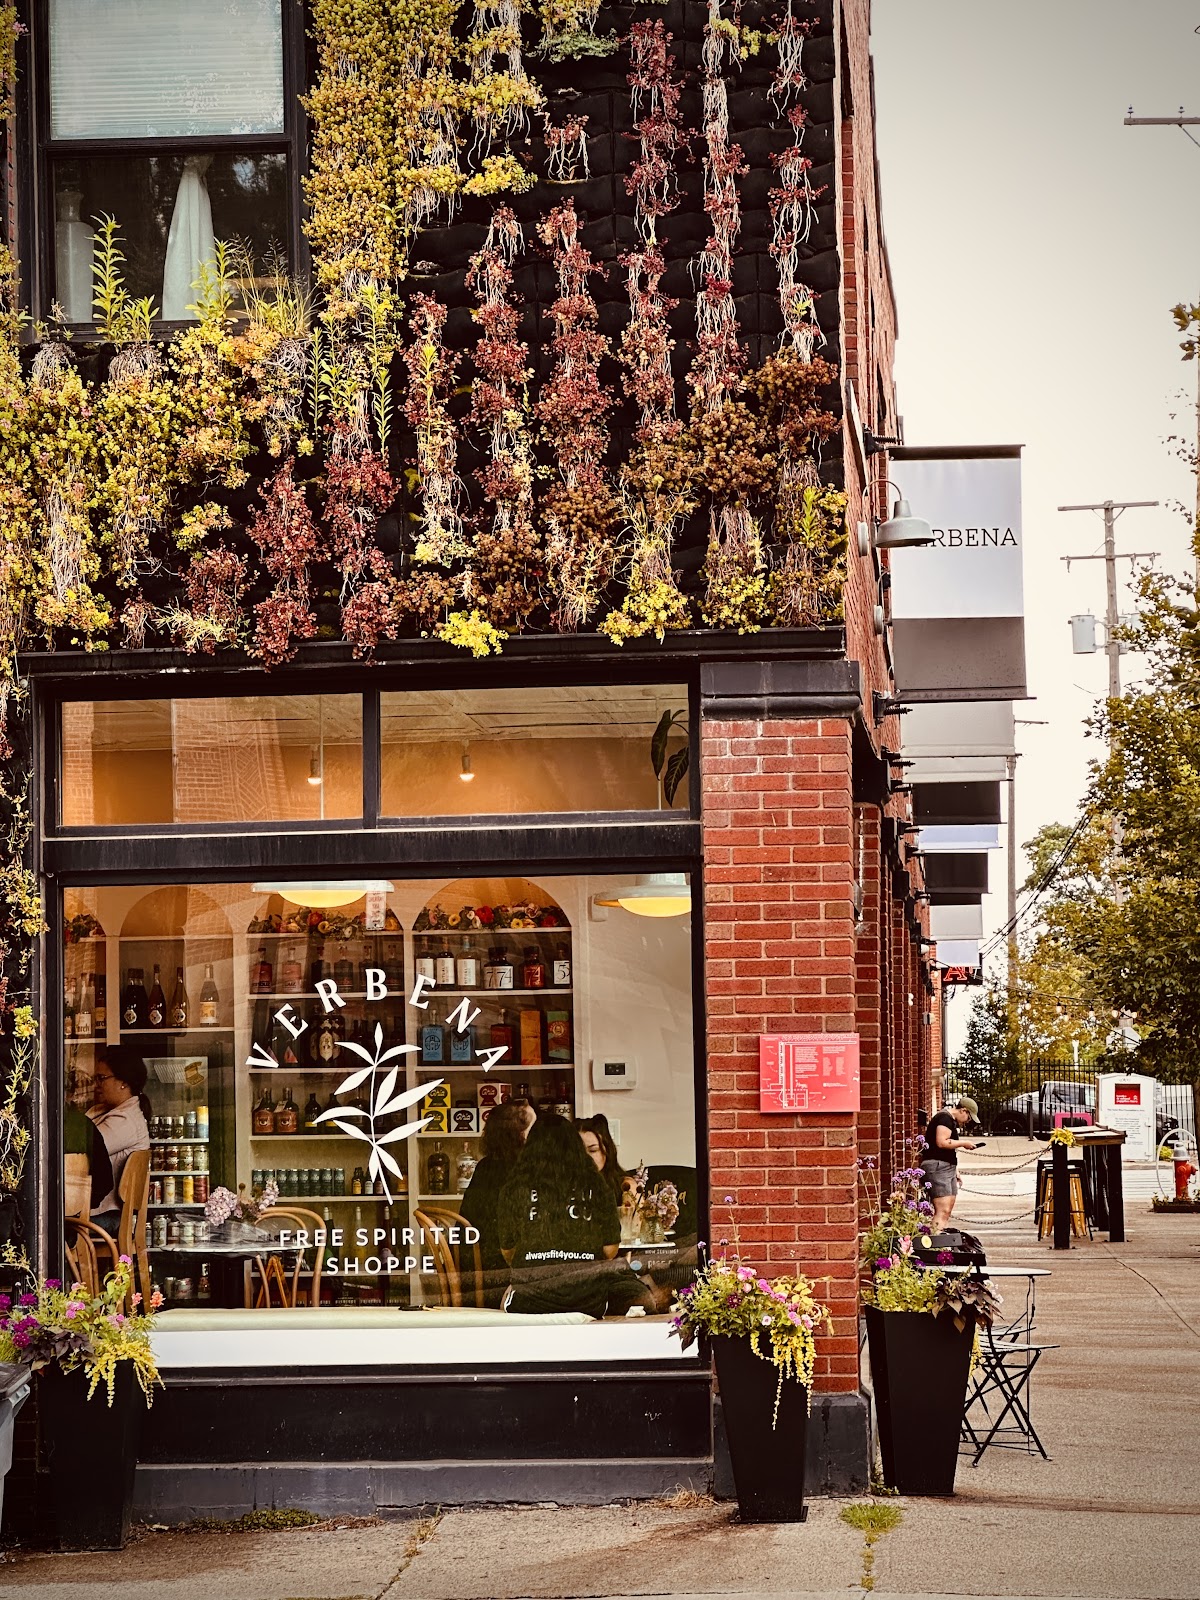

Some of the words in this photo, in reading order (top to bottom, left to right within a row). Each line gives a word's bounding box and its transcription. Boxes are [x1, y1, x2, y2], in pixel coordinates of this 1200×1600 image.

[914, 527, 1018, 547] RBENA
[245, 968, 509, 1072] VERBENA
[279, 1229, 344, 1248] FREE
[356, 1226, 481, 1247] SPIRITED
[326, 1255, 436, 1275] SHOPPE
[525, 1249, 595, 1261] alwaysfit4you.com
